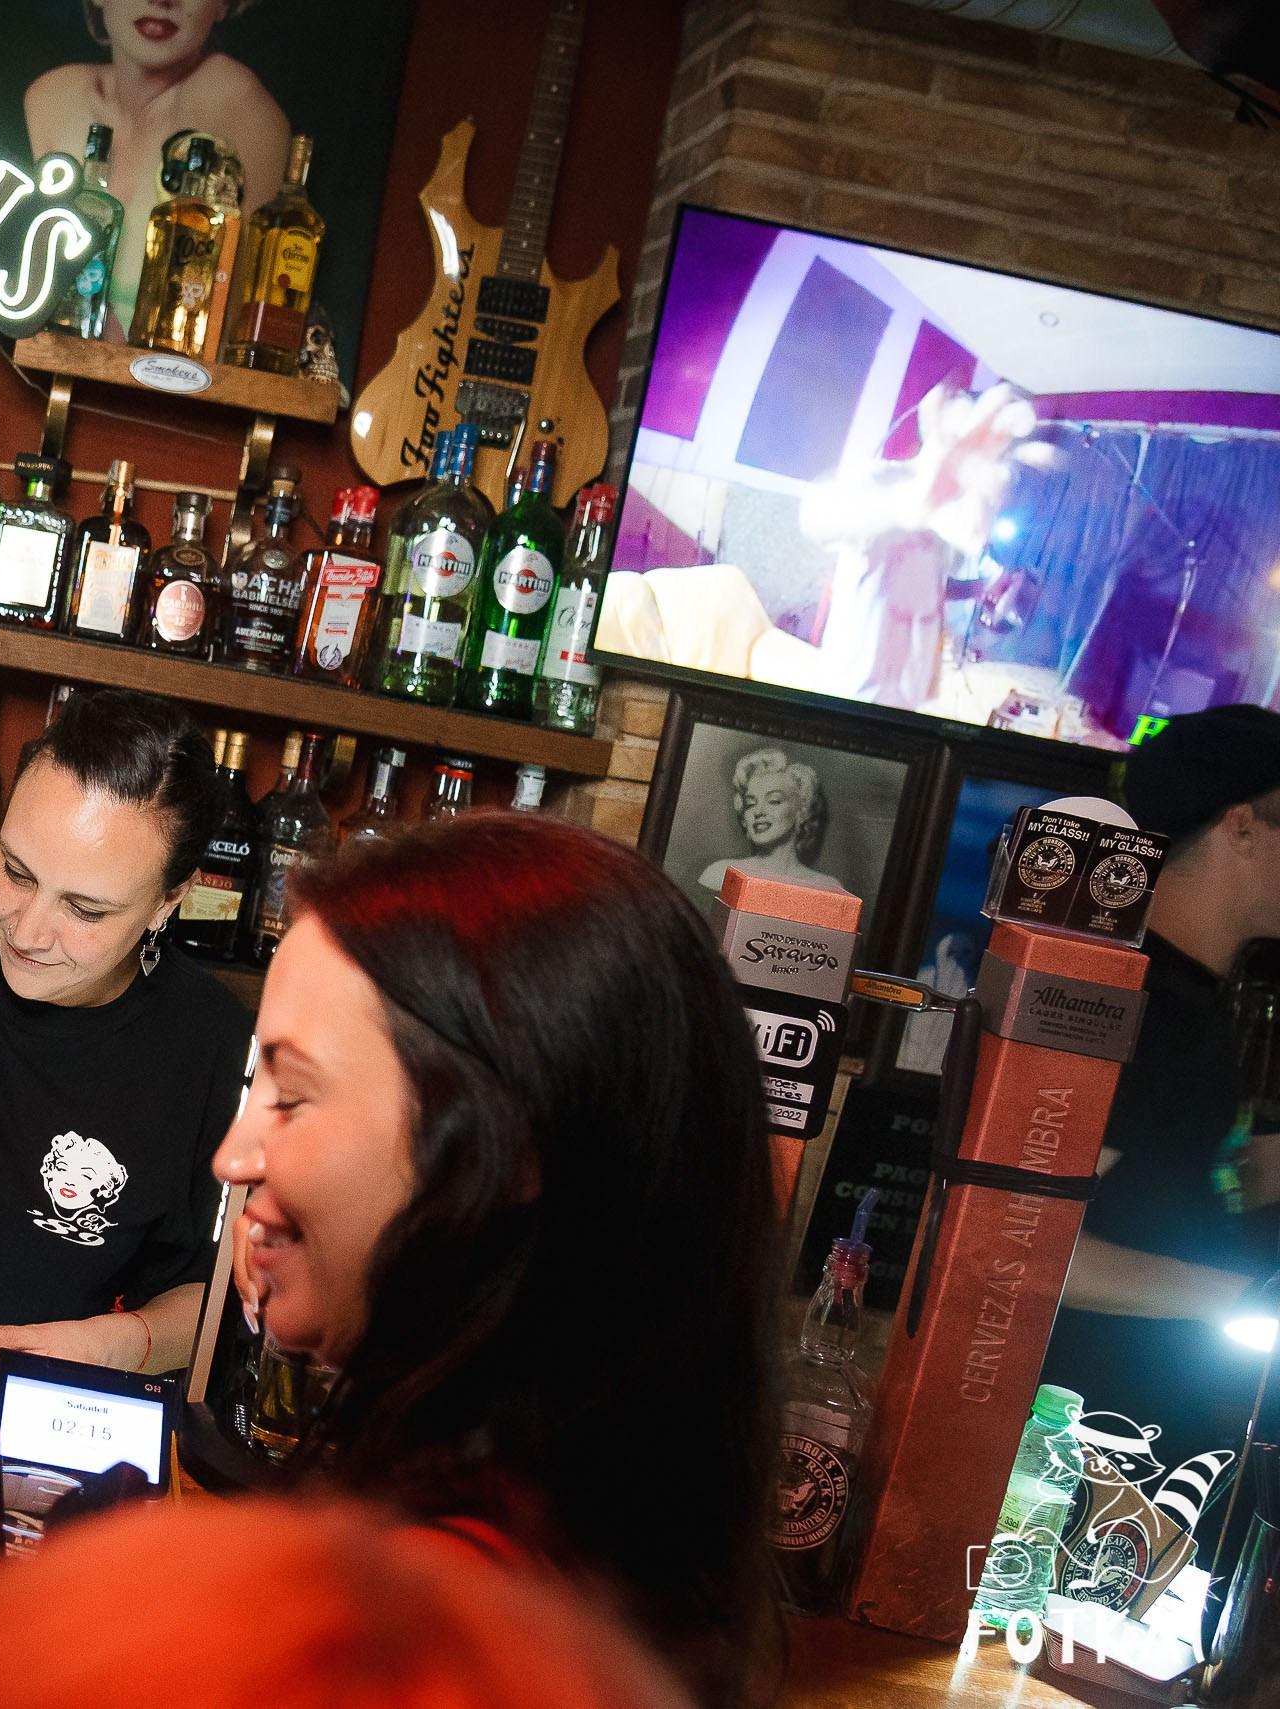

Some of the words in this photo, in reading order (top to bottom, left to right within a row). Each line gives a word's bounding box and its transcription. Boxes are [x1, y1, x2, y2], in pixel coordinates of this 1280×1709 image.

[414, 243, 474, 402] Fighters
[417, 553, 471, 576] MARTINI
[497, 570, 552, 594] MARTINI
[1027, 822, 1045, 833] MY
[1045, 824, 1091, 842] GLASS!!
[1042, 815, 1063, 827] Don't
[1063, 818, 1081, 829] take
[1099, 838, 1117, 849] MY
[1117, 840, 1163, 859] GLASS!!
[1114, 831, 1135, 843] Don't
[738, 938, 840, 971] Sarango
[1029, 986, 1126, 1021] Alhambra
[753, 1022, 812, 1057] iFi
[775, 1106, 803, 1122] 2022
[959, 1257, 1027, 1404] CERVEZAS
[1004, 1085, 1074, 1250] ALHMBRA
[805, 1459, 833, 1498] ROCK
